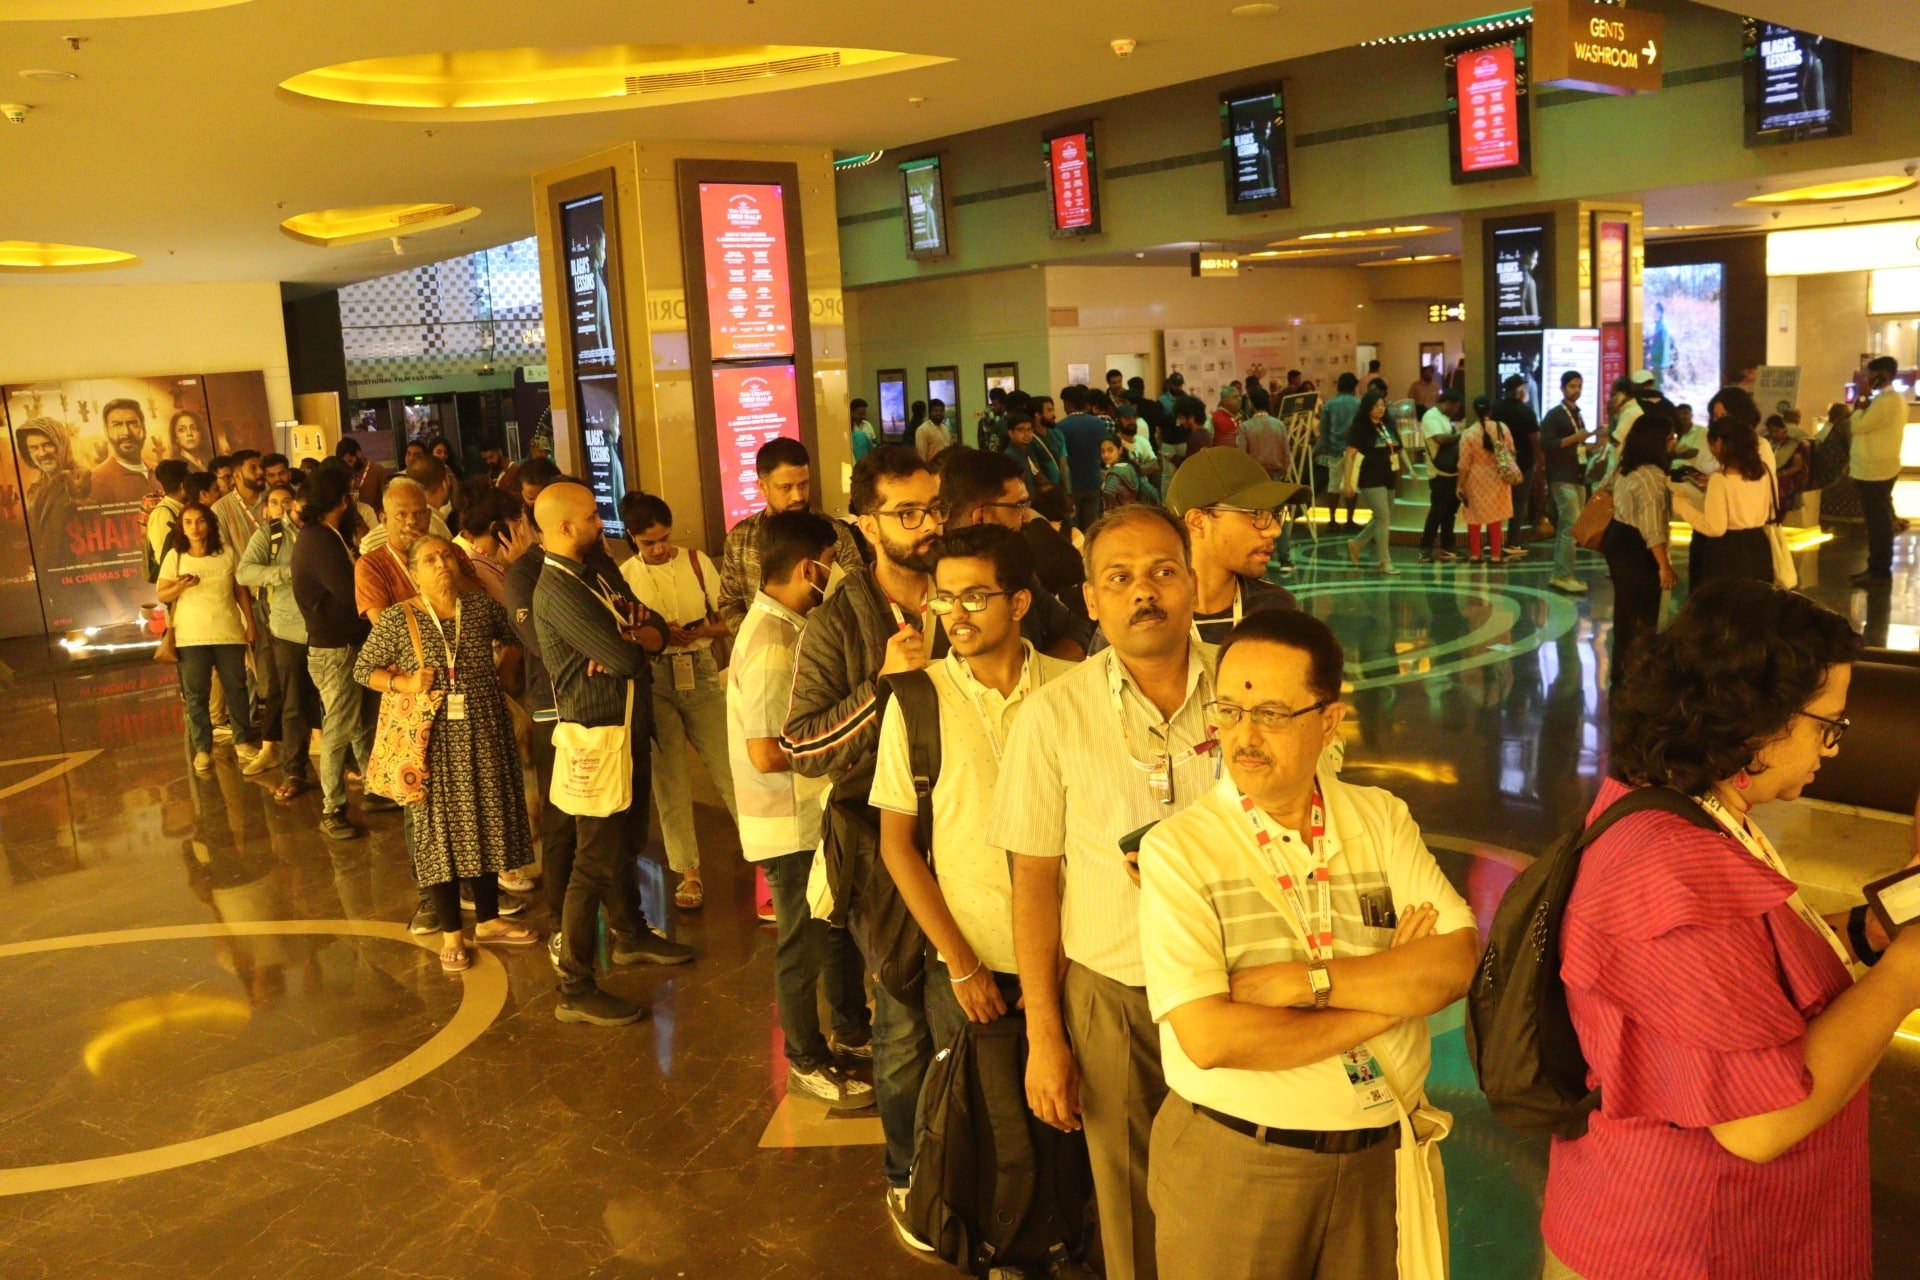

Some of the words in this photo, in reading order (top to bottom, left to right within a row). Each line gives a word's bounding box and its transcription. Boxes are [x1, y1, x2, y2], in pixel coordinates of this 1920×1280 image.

[1590, 17, 1625, 41] GENTS
[1574, 41, 1638, 69] WASHROOM
[1765, 49, 1803, 70] LESSONS
[62, 576, 73, 585] IN
[75, 570, 120, 583] CINEMAS
